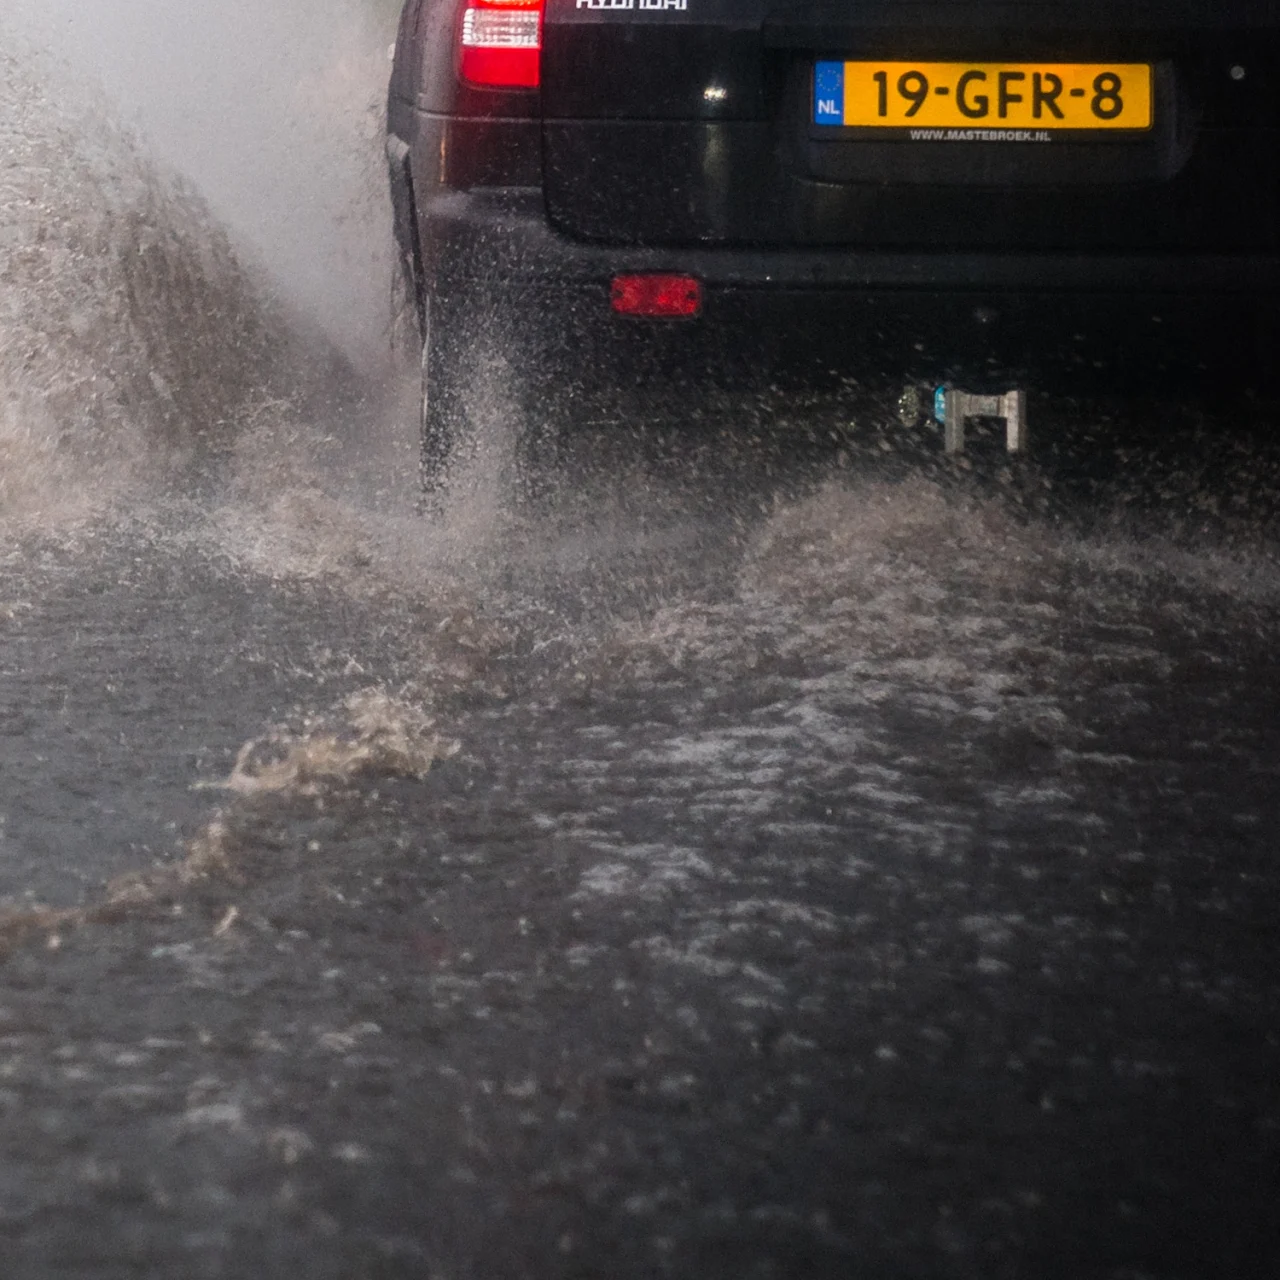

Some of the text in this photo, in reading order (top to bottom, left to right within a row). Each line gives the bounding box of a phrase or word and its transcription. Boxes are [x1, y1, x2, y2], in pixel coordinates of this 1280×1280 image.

[873, 70, 1124, 120] 19-GFR-8
[818, 100, 840, 115] NL
[910, 129, 1051, 141] WWW.MASTEBROEK.NL
